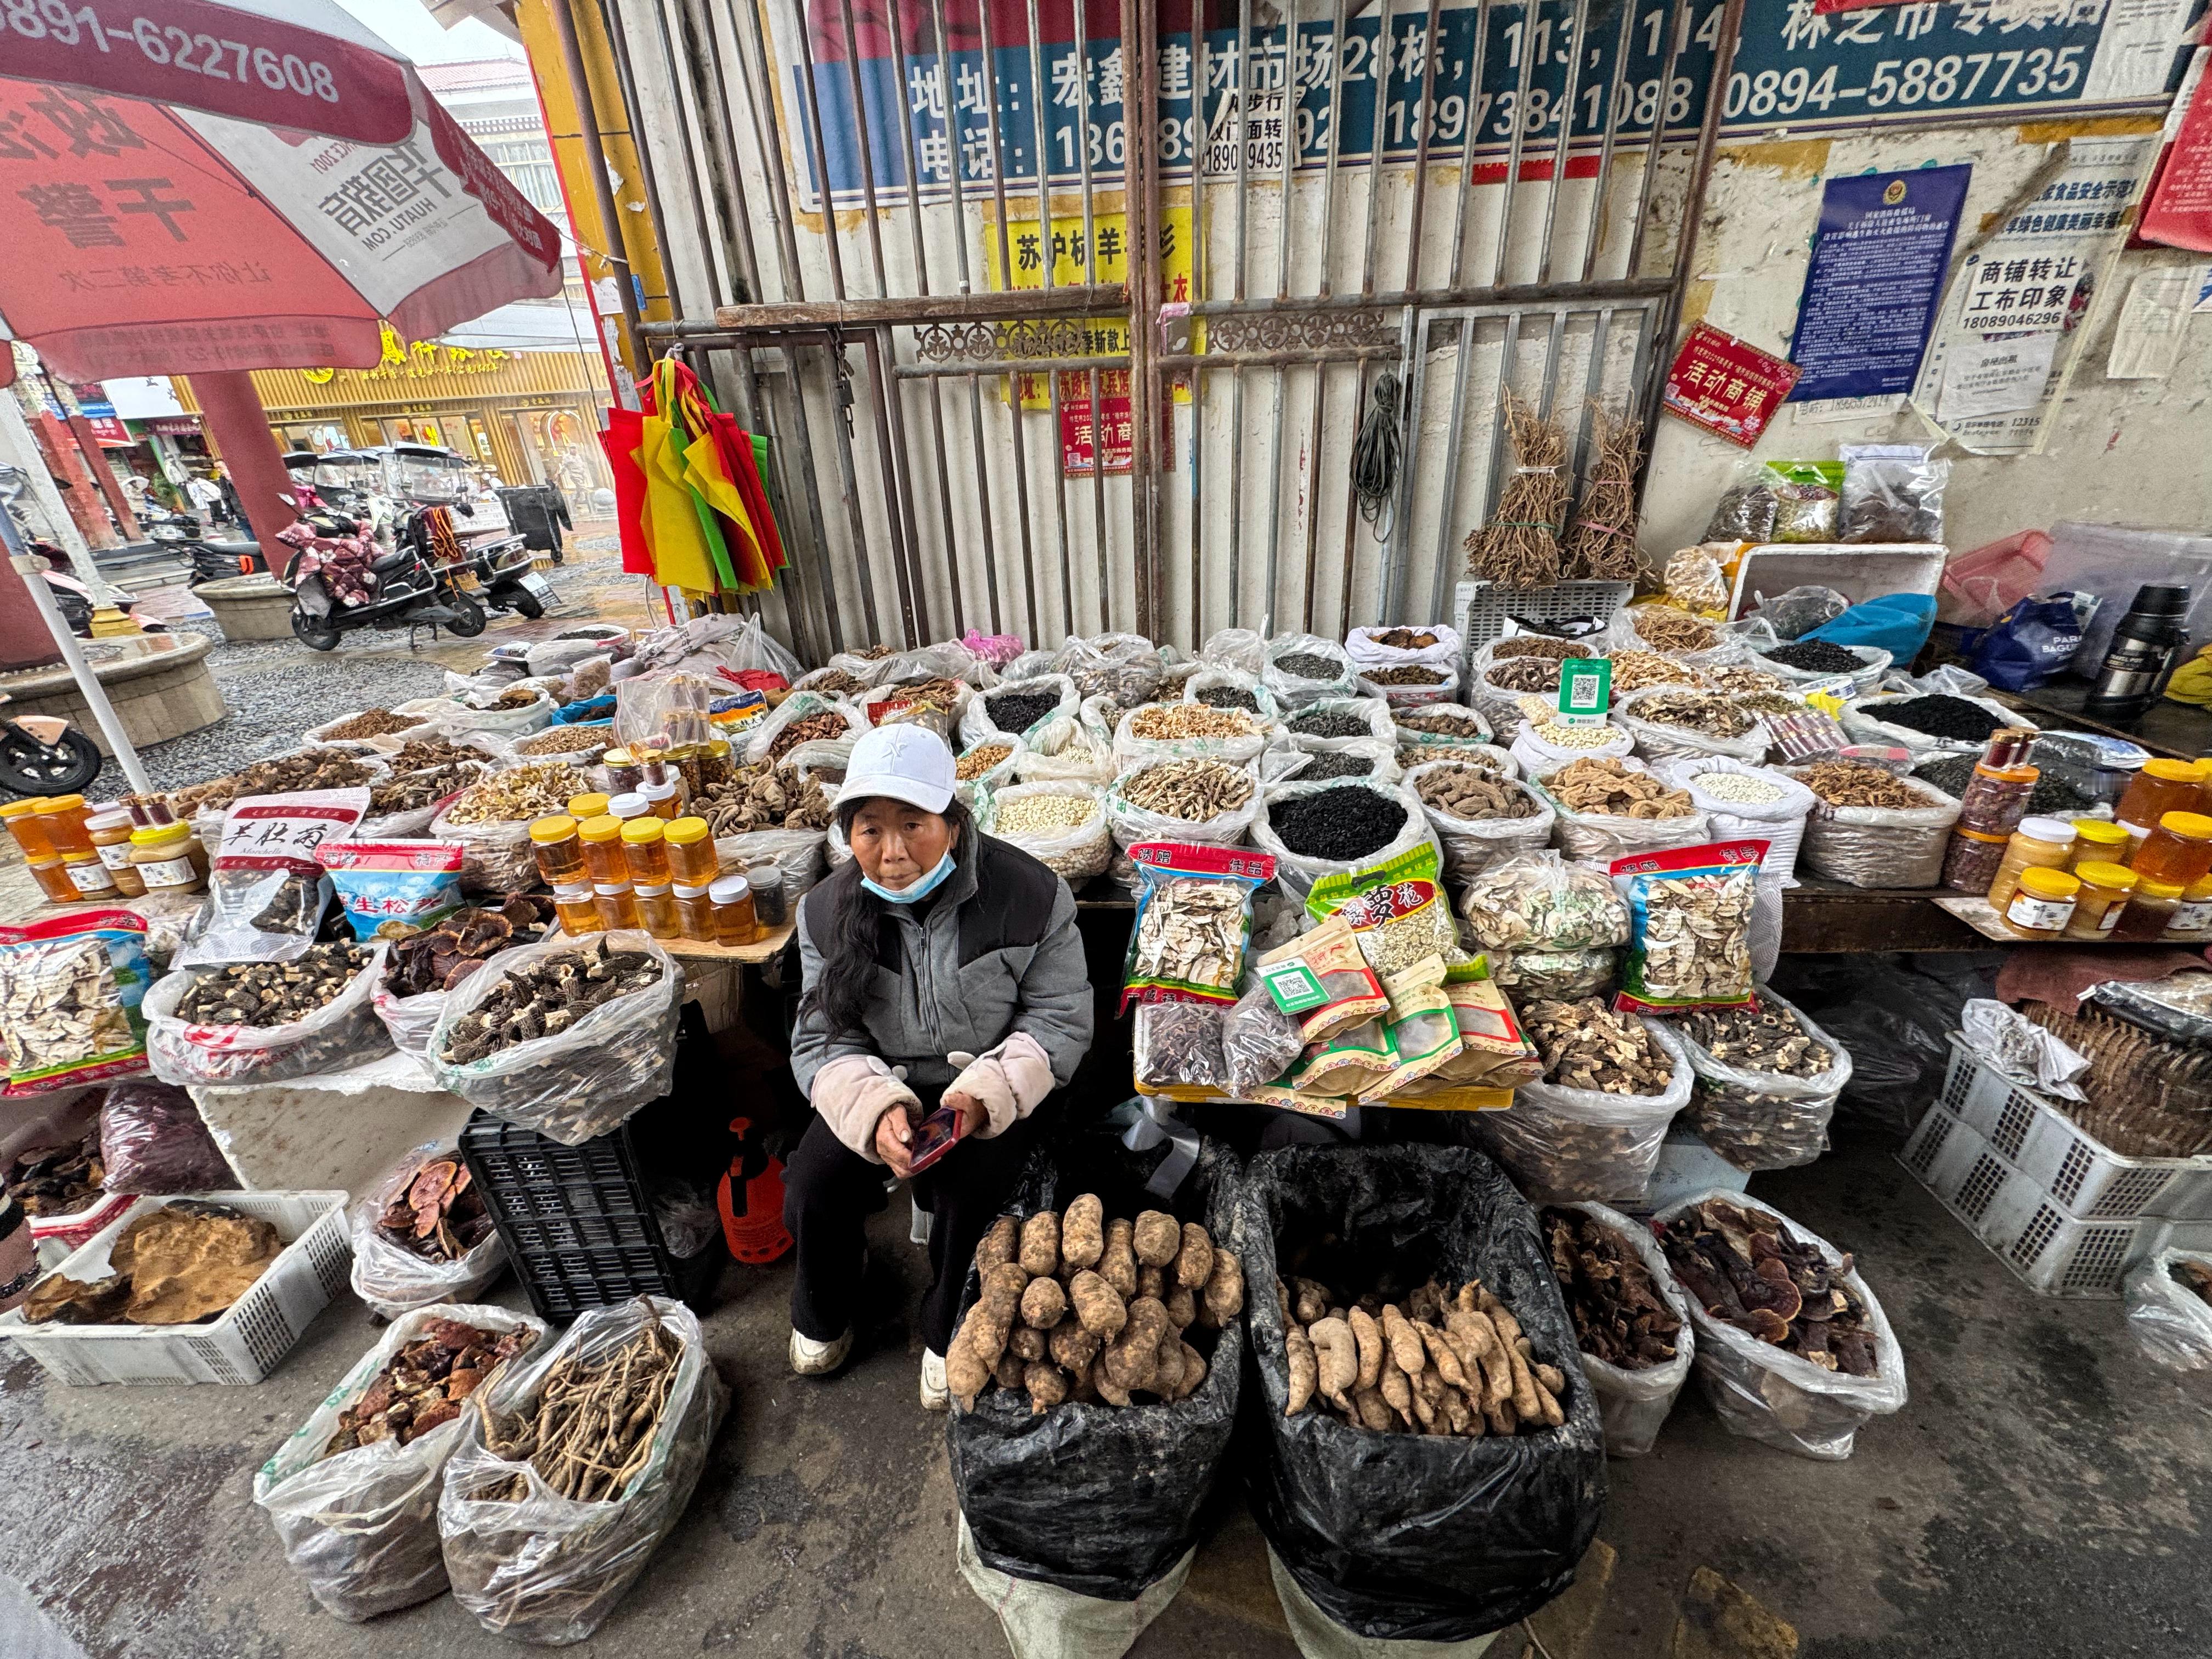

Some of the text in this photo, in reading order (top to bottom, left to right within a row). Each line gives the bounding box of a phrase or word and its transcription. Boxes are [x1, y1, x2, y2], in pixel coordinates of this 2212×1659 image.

[0, 0, 338, 103] 891-6227608
[1723, 46, 2085, 118] 0894-5887735
[1979, 257, 2078, 285] 商铺转让
[1970, 285, 2067, 312] 工布印象
[1962, 313, 2061, 330] 18089046296
[1683, 360, 1768, 415] 活动商铺
[222, 821, 328, 850] 羊肚菌
[324, 852, 357, 865] 西藏
[1138, 848, 1265, 876] 馈赠 佳品
